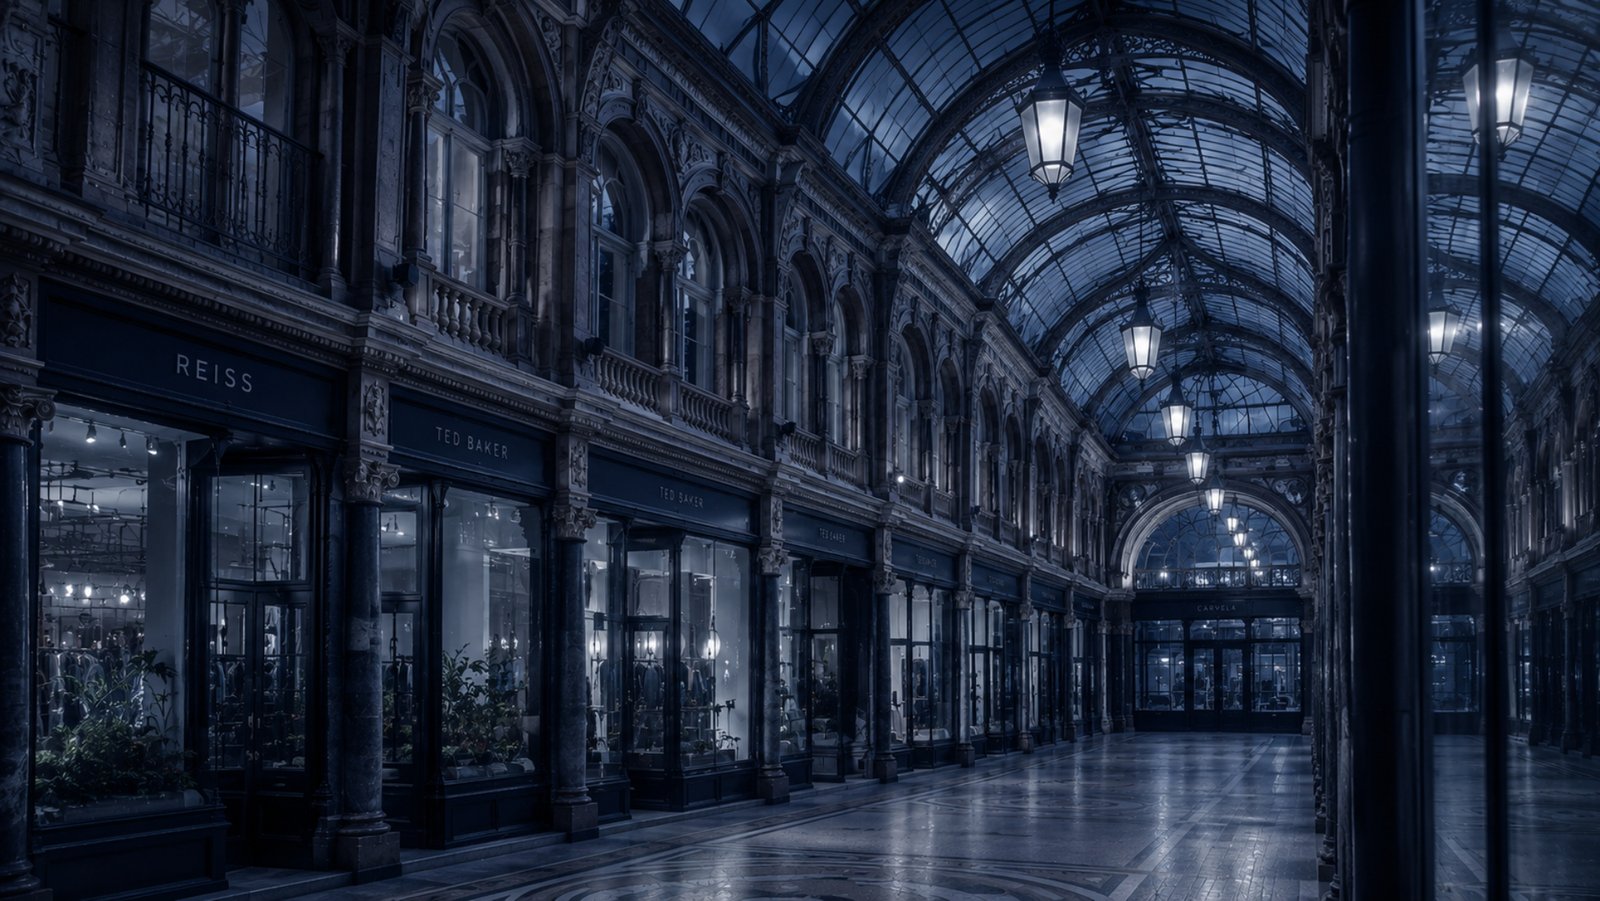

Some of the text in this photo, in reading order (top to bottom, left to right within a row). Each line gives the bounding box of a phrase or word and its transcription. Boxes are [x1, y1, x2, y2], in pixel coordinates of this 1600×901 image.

[176, 353, 252, 393] REISS
[436, 426, 508, 460] TED BAKER
[660, 486, 675, 501] TED
